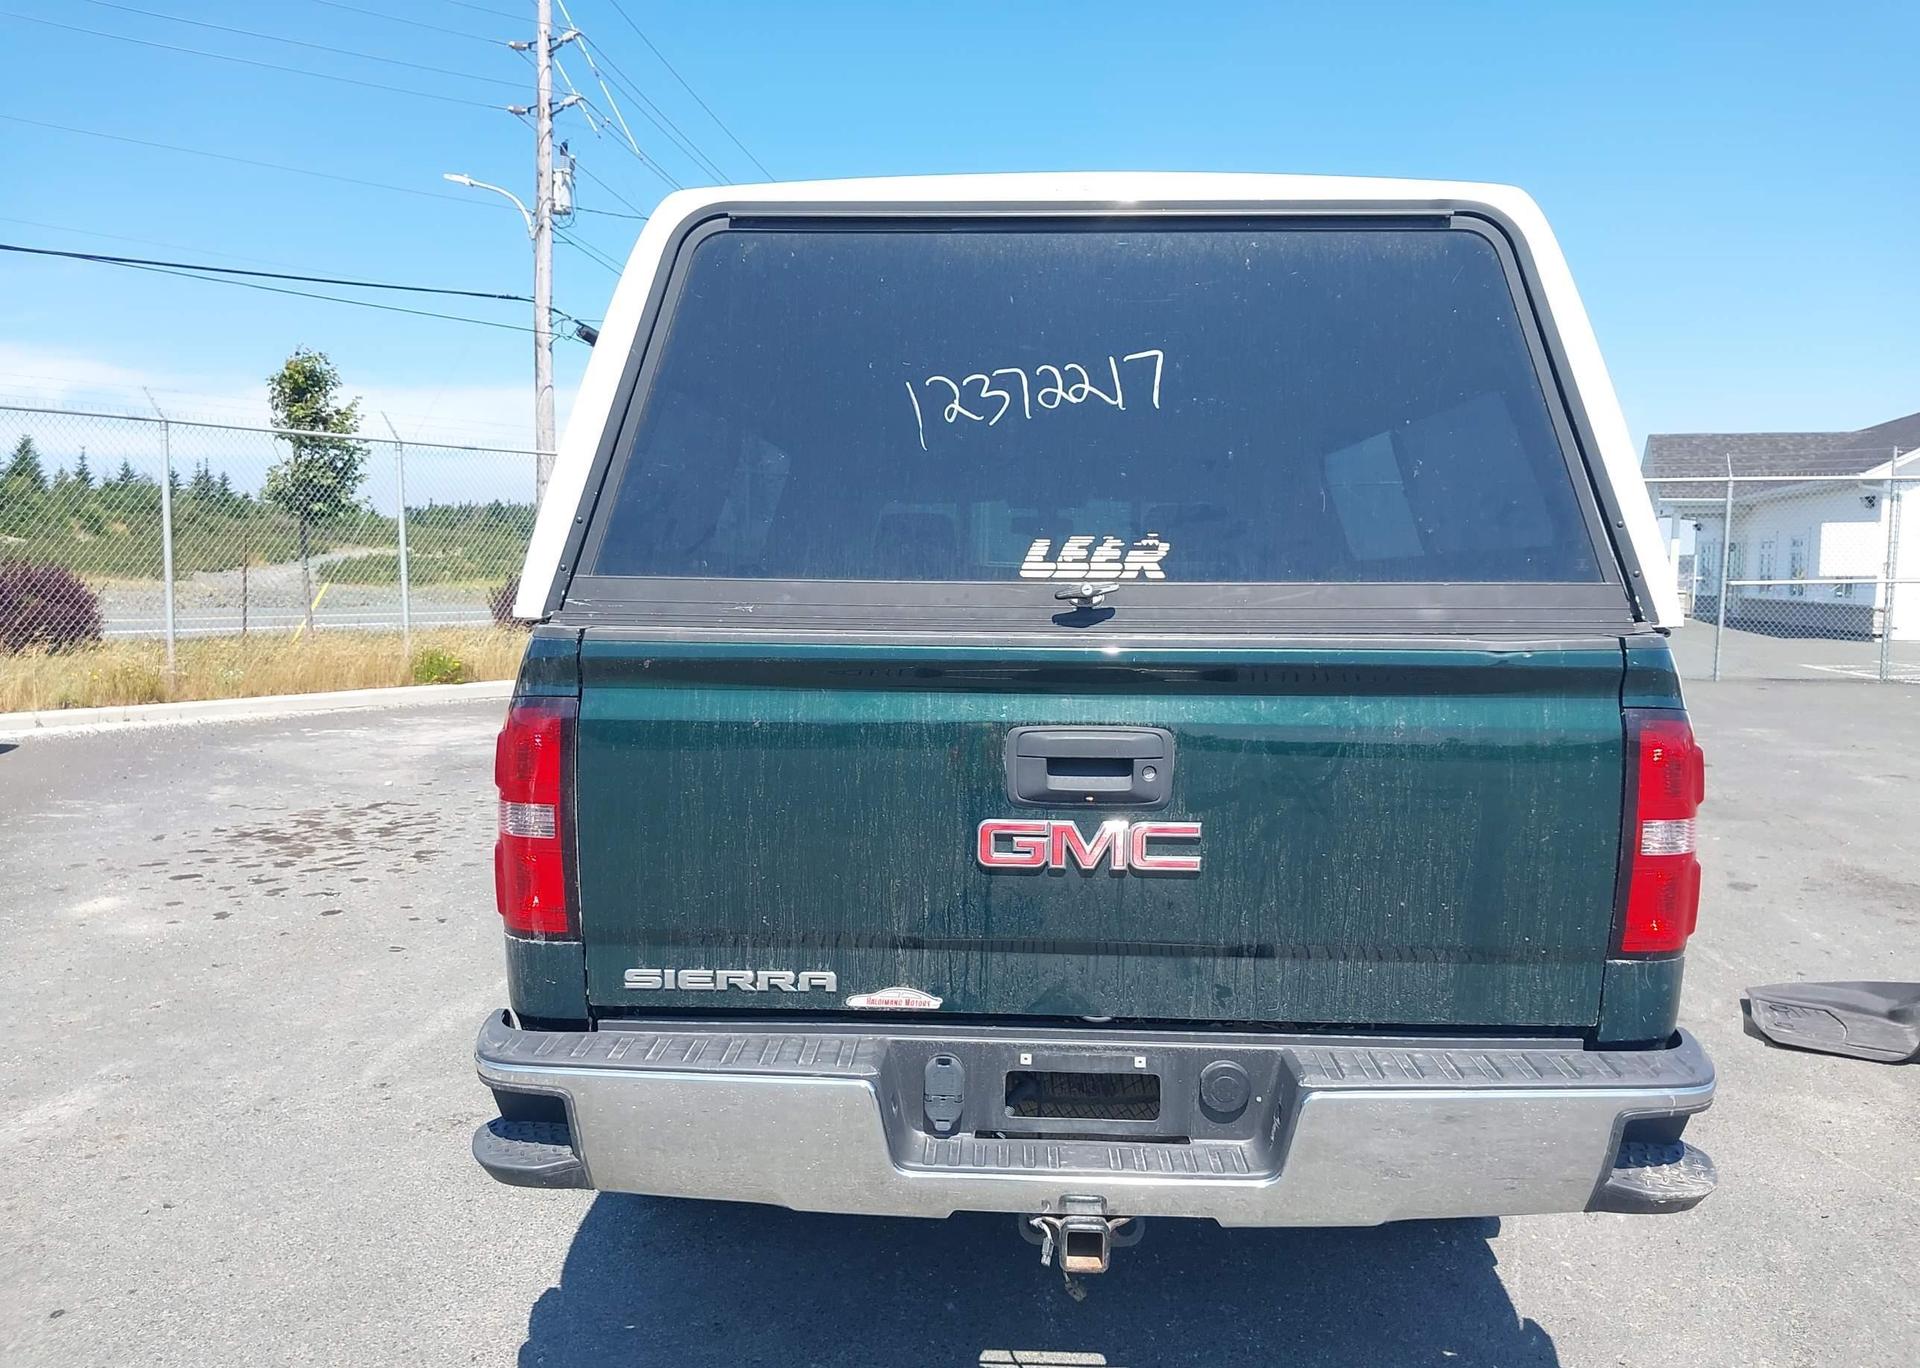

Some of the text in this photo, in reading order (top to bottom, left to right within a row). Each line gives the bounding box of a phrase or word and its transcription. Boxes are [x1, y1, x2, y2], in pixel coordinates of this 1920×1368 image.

[905, 350, 1163, 451] 12372217
[1019, 533, 1170, 578] LEER
[978, 819, 1202, 870] GMC
[624, 968, 837, 992] SIERRA
[905, 999, 931, 1007] MOTORS
